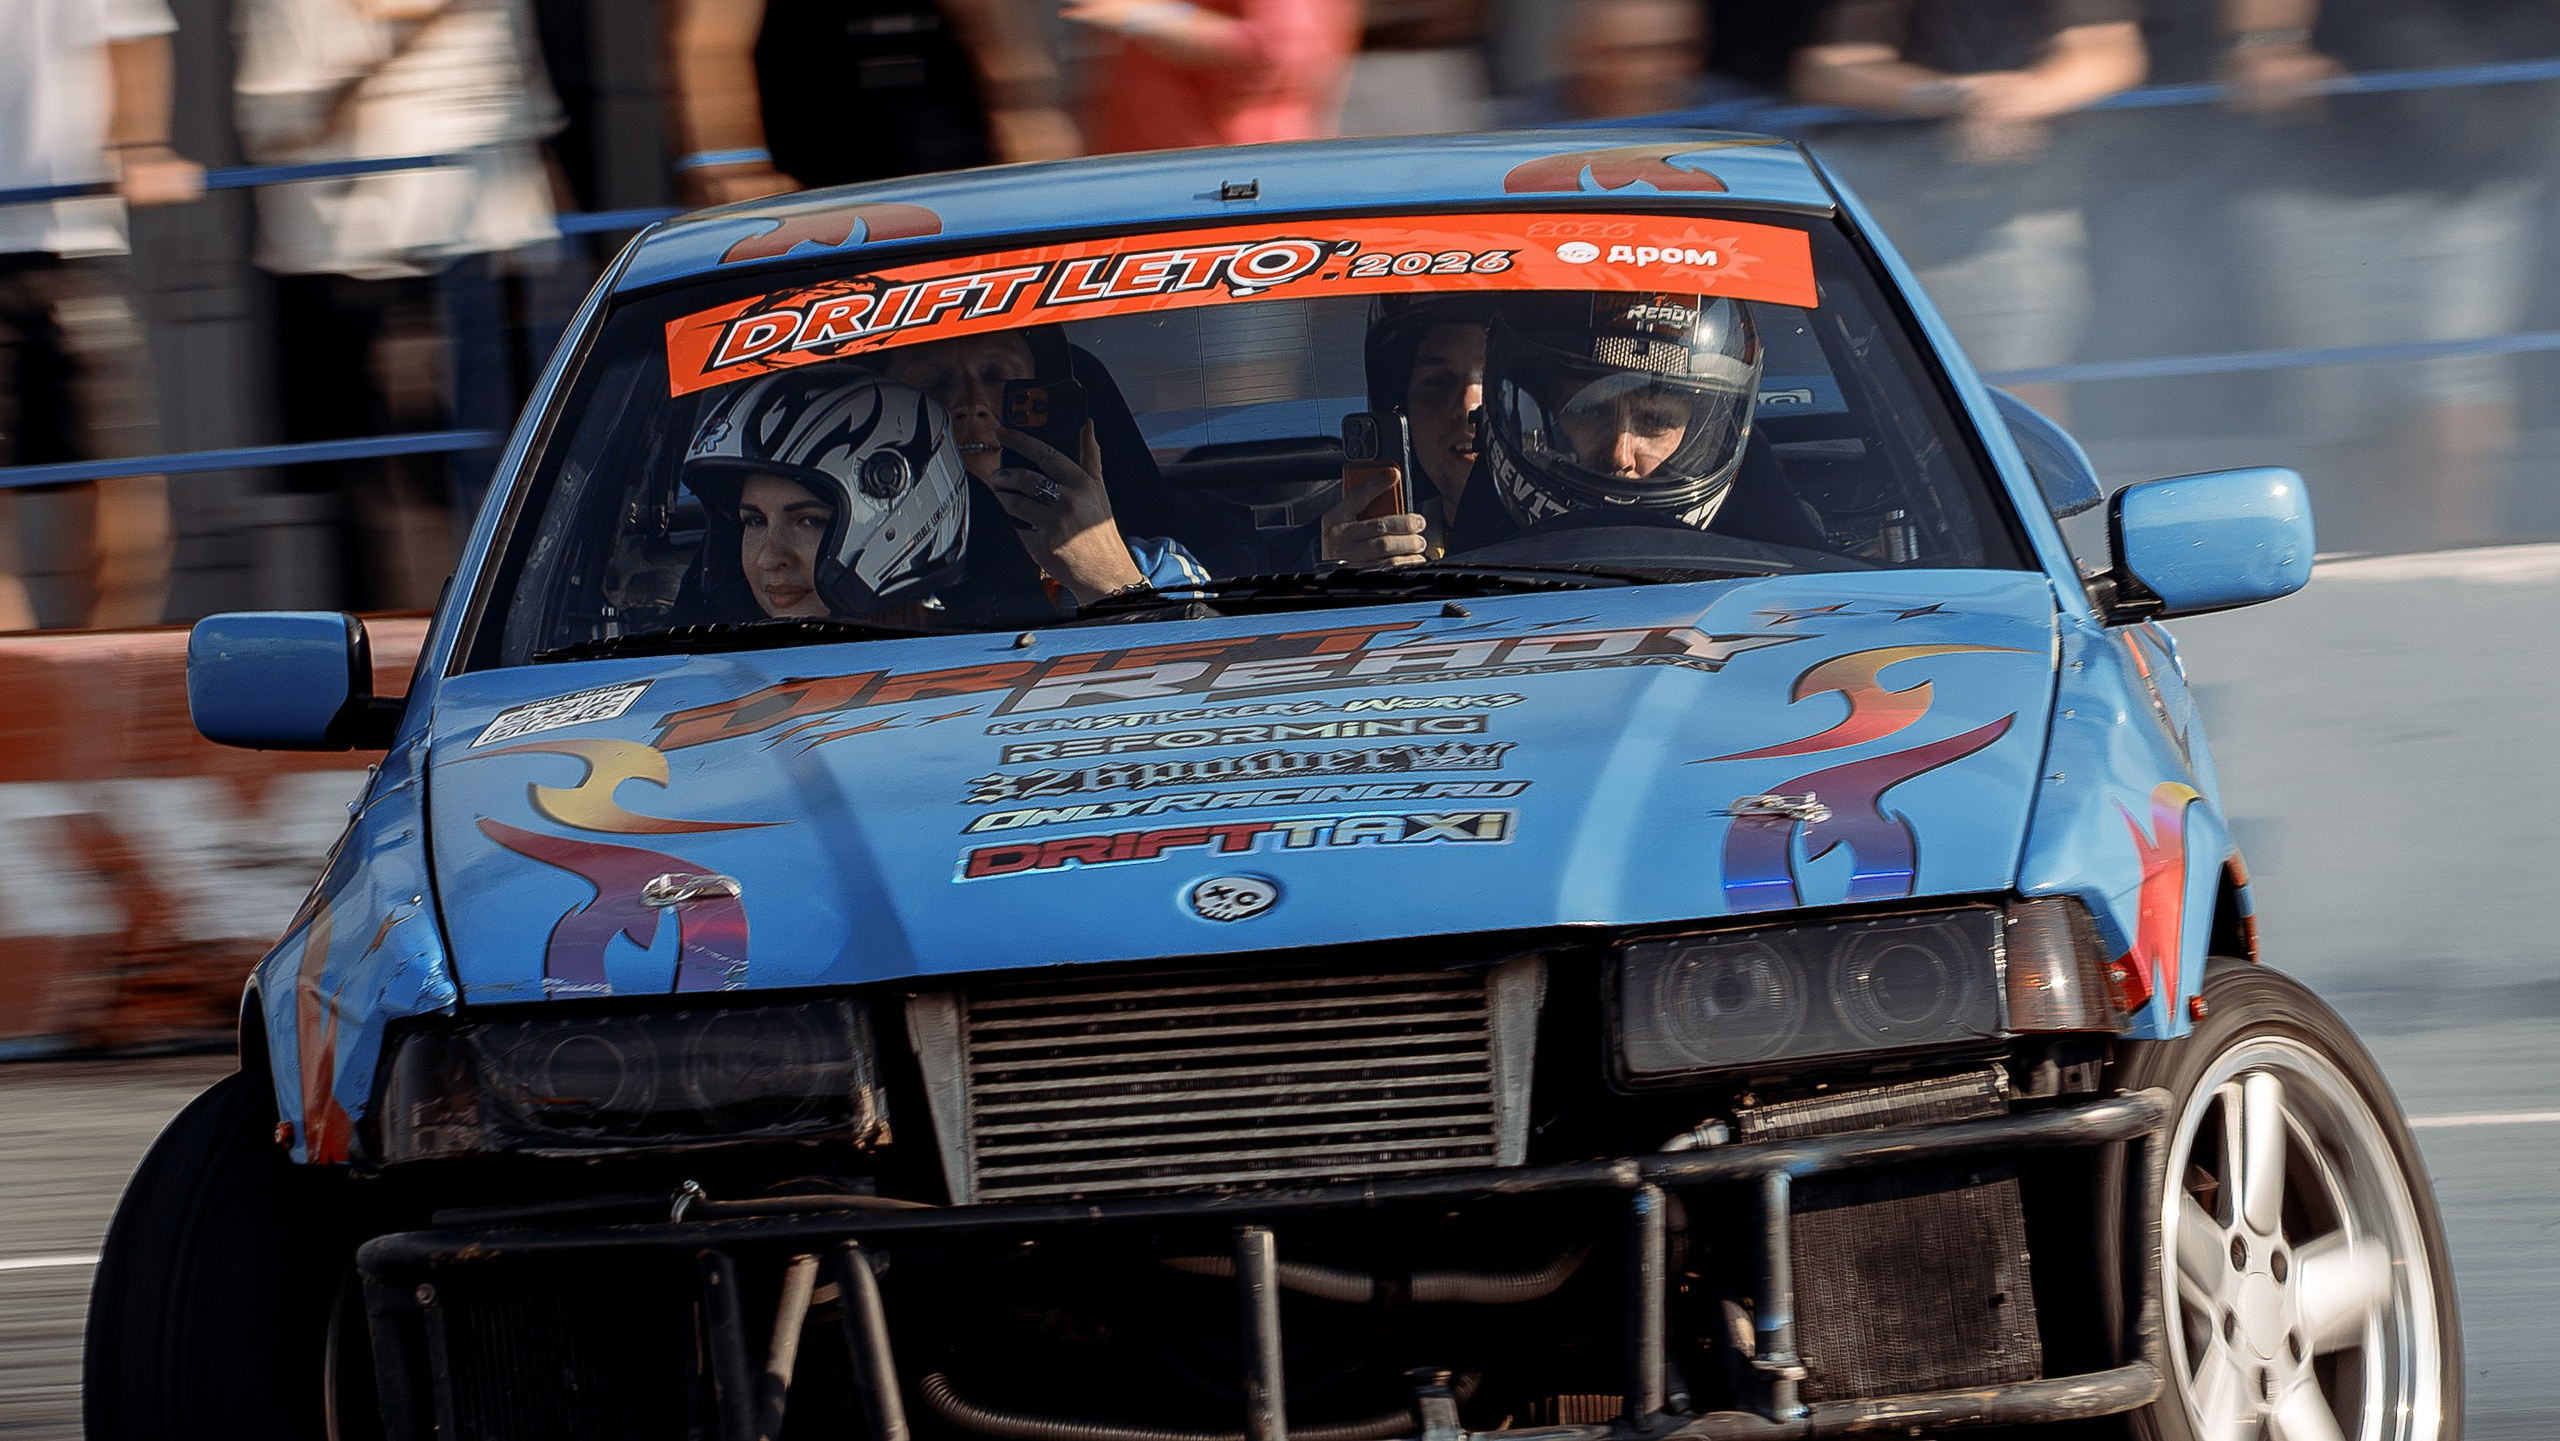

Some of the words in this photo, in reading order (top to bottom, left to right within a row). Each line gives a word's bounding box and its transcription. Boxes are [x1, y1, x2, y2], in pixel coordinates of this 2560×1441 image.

[1606, 244, 1718, 268] дром
[712, 266, 1041, 368] DRIFT
[1046, 238, 1323, 305] LETO
[1350, 249, 1514, 279] 2026
[1626, 303, 1699, 322] READY
[1006, 626, 1812, 713] READY
[1366, 664, 1553, 686] SCHOOL
